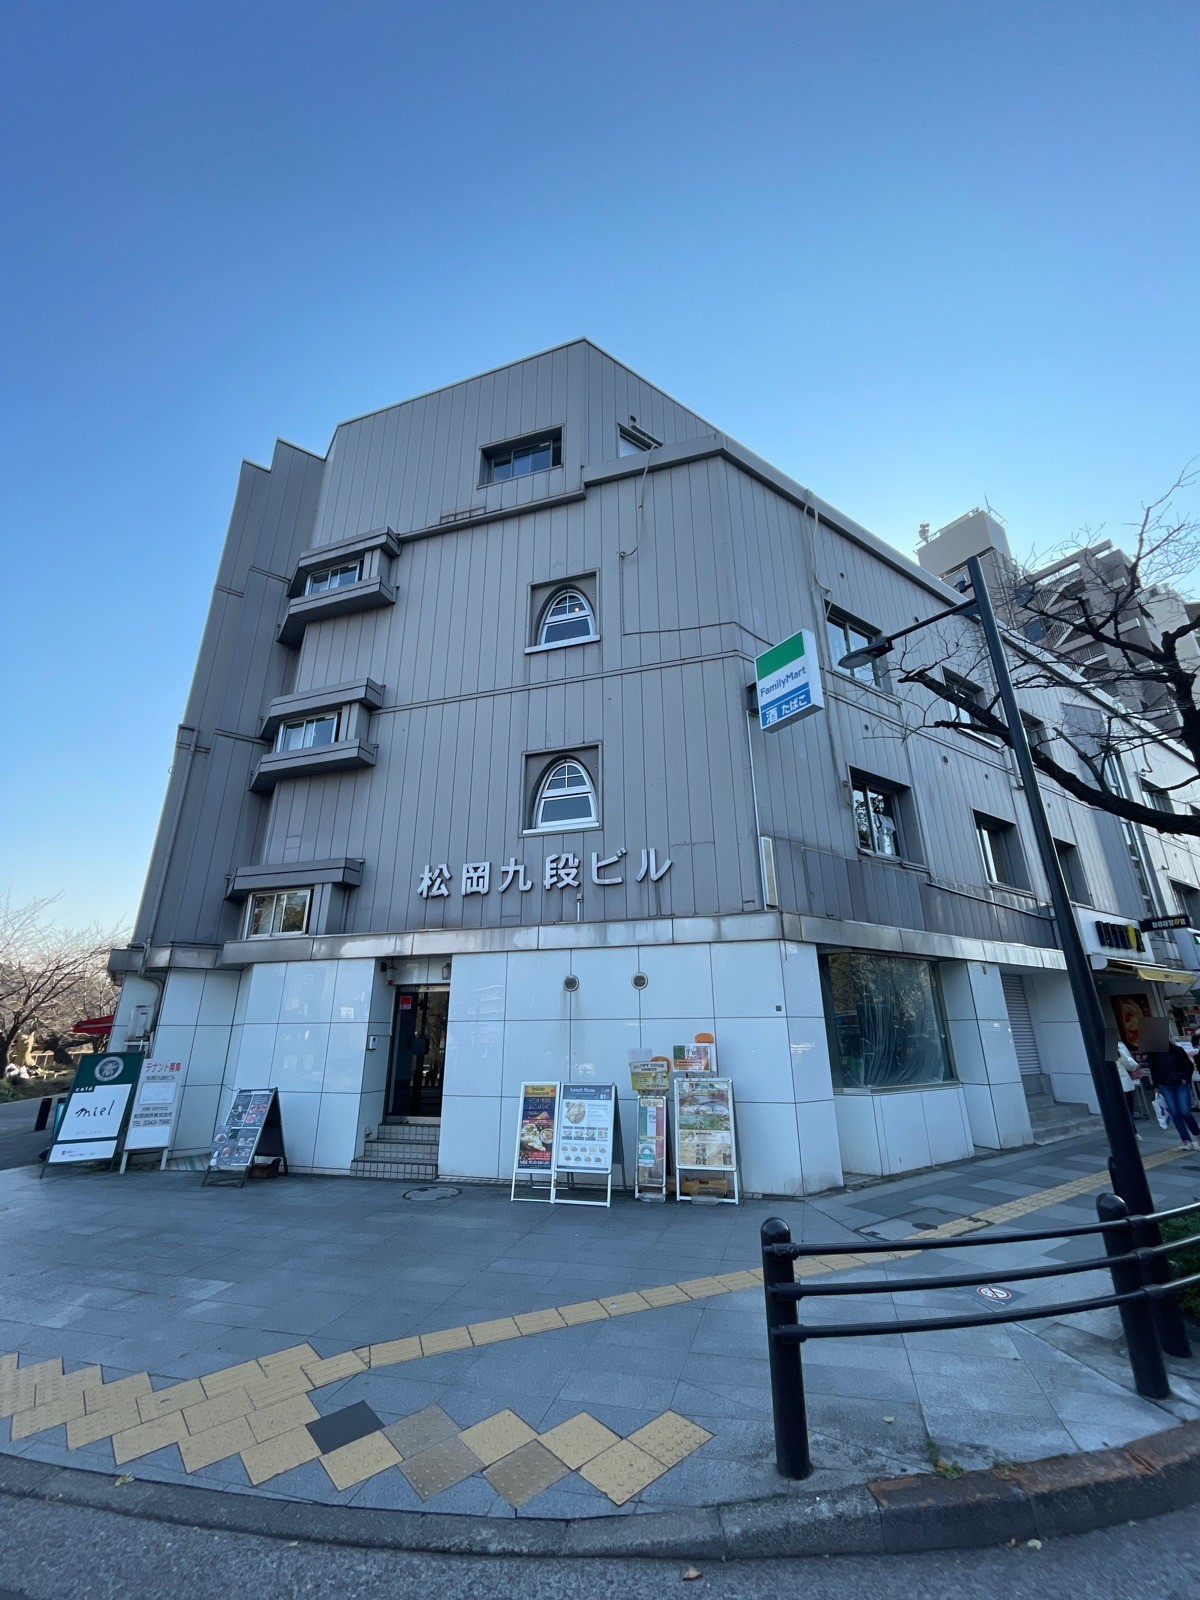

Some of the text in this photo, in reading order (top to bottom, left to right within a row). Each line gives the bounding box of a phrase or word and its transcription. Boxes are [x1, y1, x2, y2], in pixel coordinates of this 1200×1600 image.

[760, 666, 807, 697] FamilyMart
[765, 694, 807, 725] 酒 たばこ
[417, 847, 673, 899] 松岡九段ビル
[75, 1100, 116, 1118] miel
